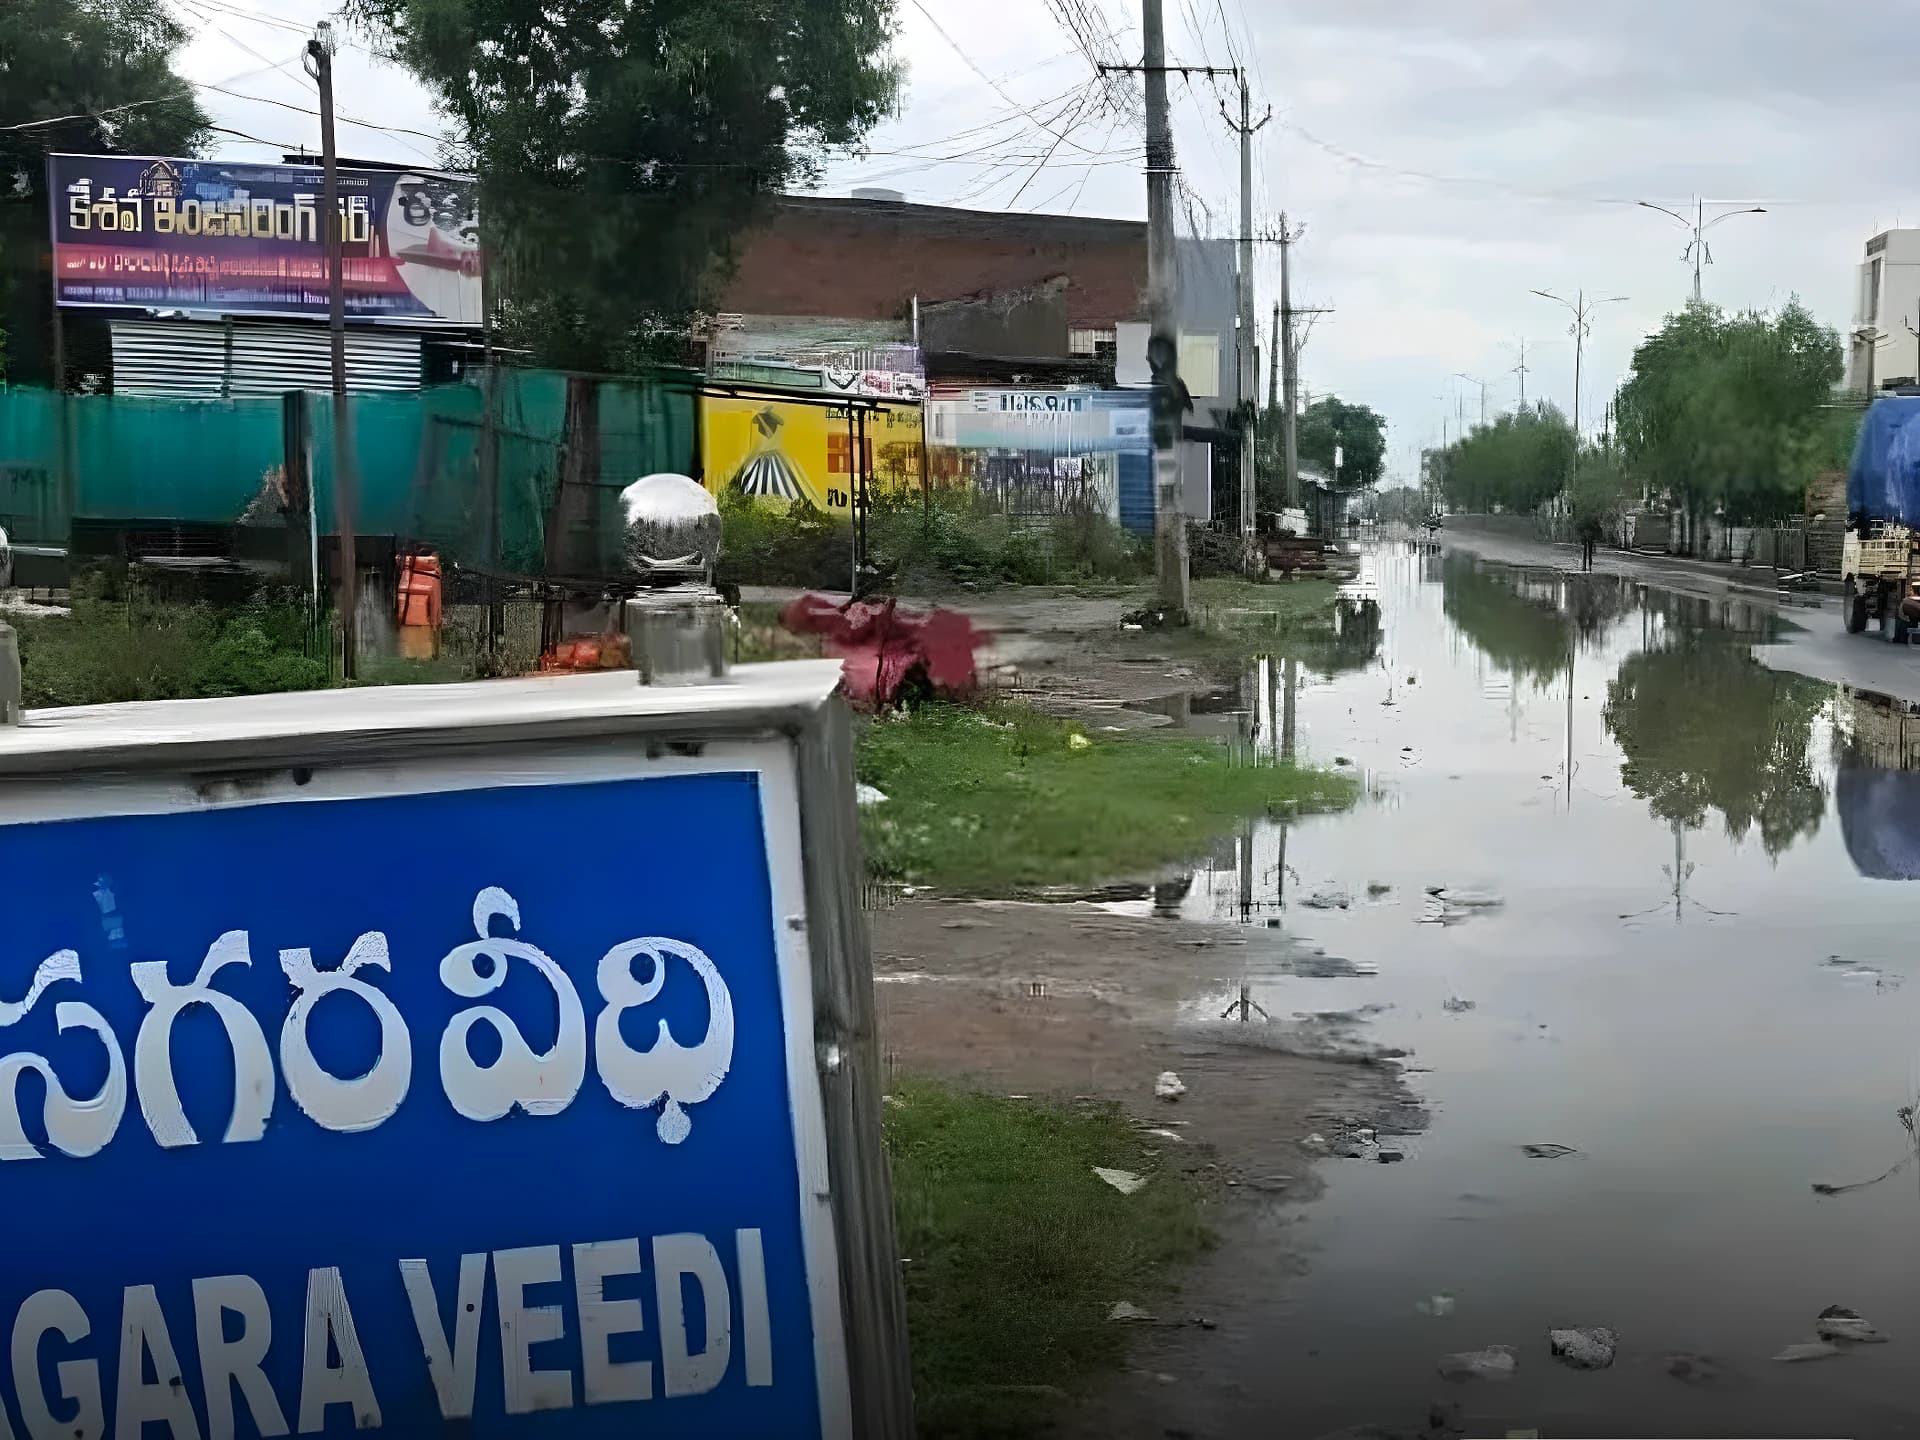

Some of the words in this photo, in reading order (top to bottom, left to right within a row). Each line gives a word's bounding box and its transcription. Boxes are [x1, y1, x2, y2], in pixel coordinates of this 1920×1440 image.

[439, 886, 735, 1145] వీధి
[0, 1267, 382, 1440] GARA
[399, 1228, 773, 1420] VEEDI
